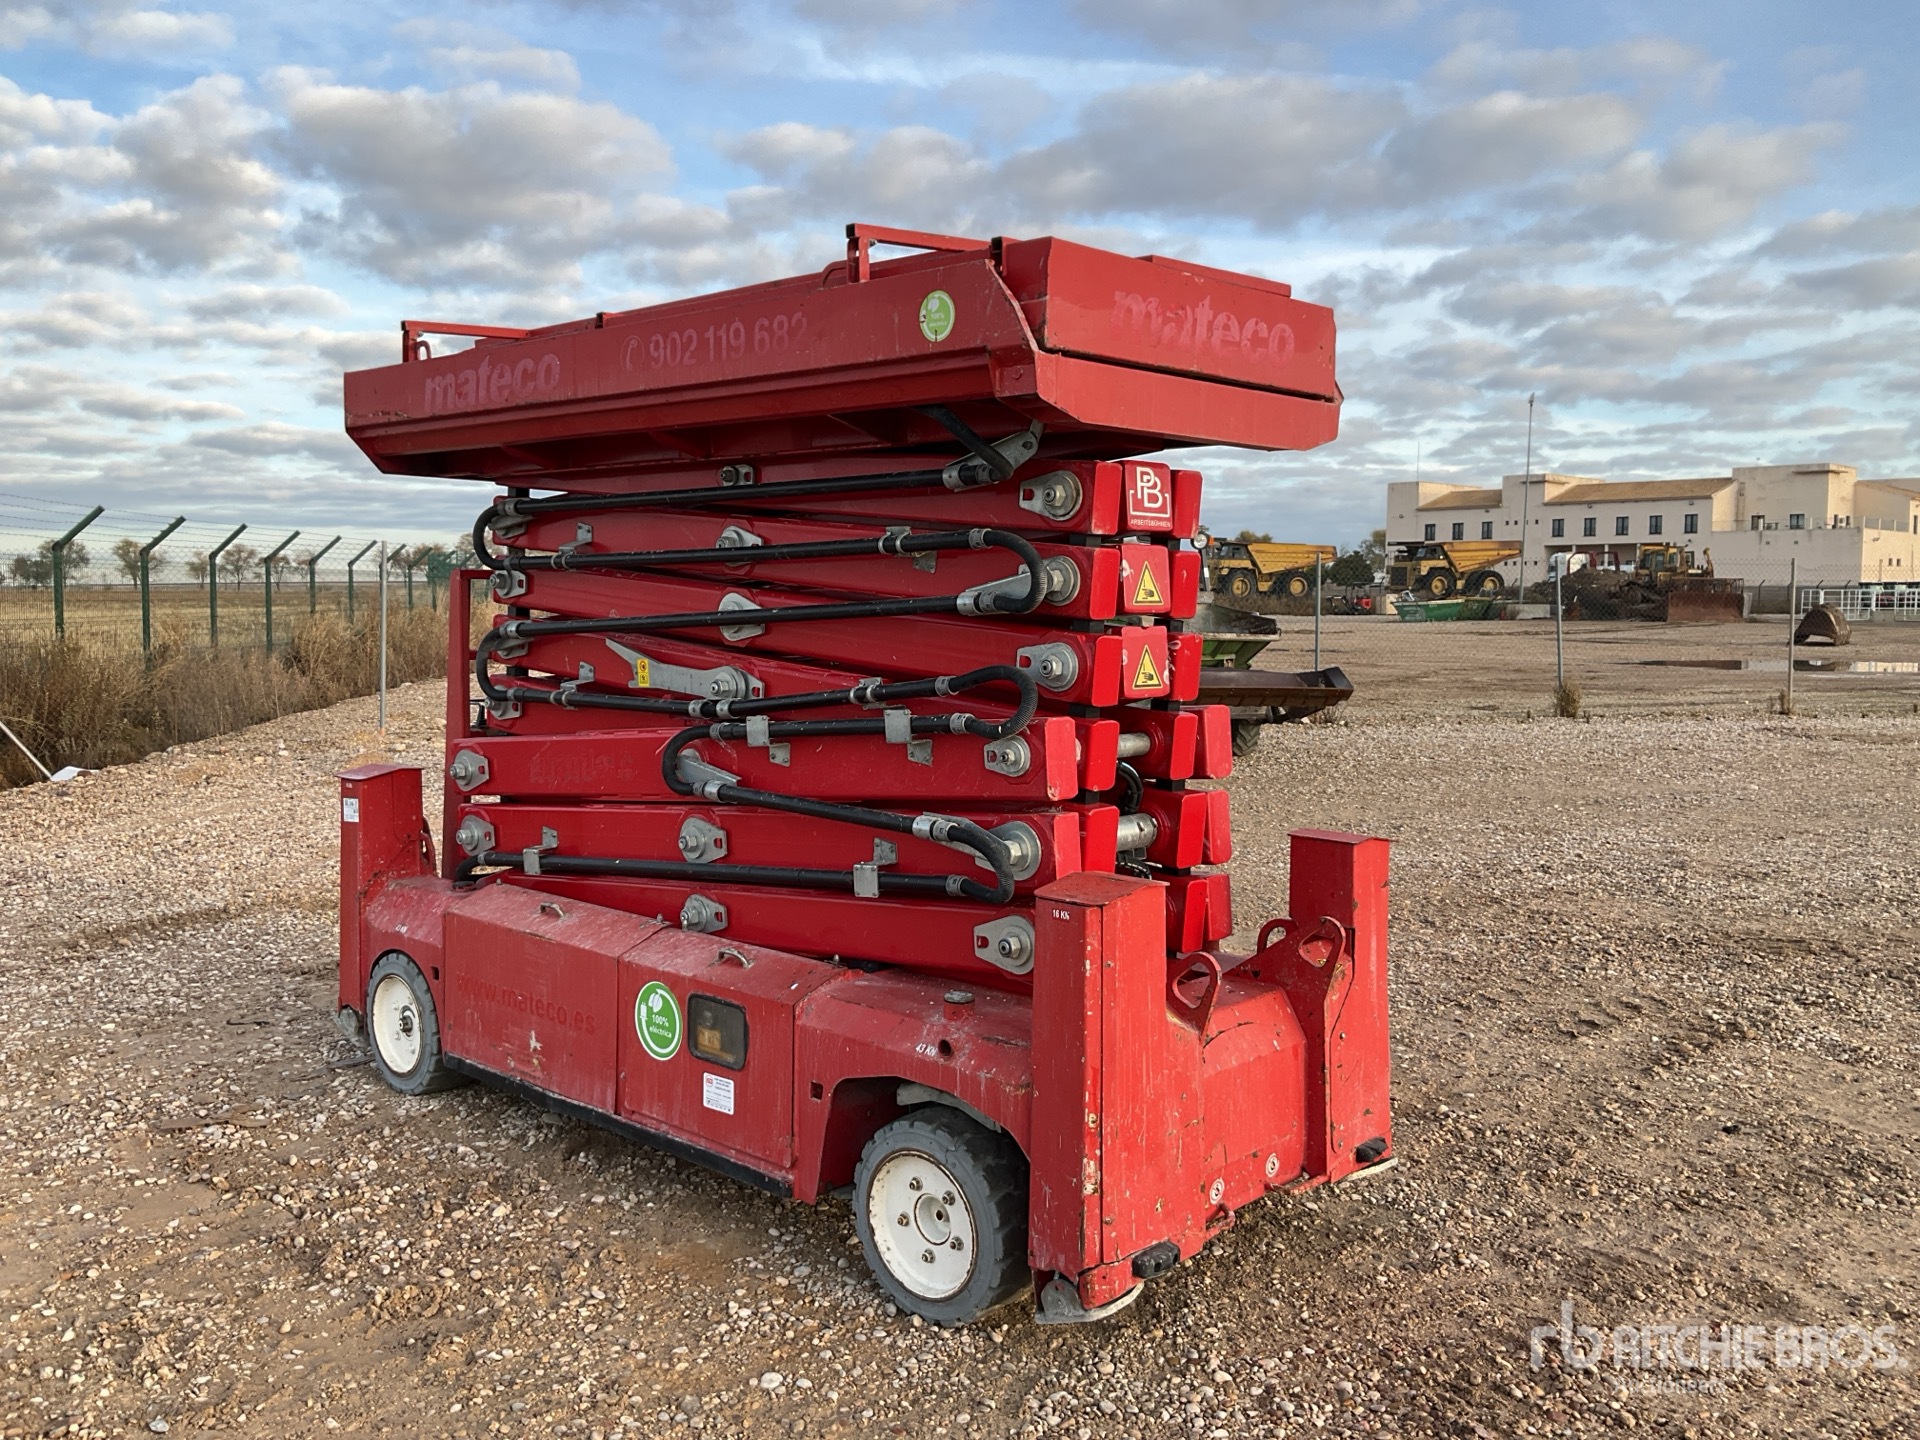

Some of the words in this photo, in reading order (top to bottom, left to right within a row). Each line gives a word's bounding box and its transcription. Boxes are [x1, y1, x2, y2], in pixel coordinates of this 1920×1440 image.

[649, 327, 698, 369] 902
[704, 317, 746, 361] 119
[752, 312, 808, 354] 682
[1111, 291, 1295, 363] mateco
[424, 352, 560, 412] mateco
[1130, 518, 1171, 528] ARBEITSBÜHNEN
[456, 973, 596, 1036] www.mateco.es
[652, 1014, 669, 1027] 100%
